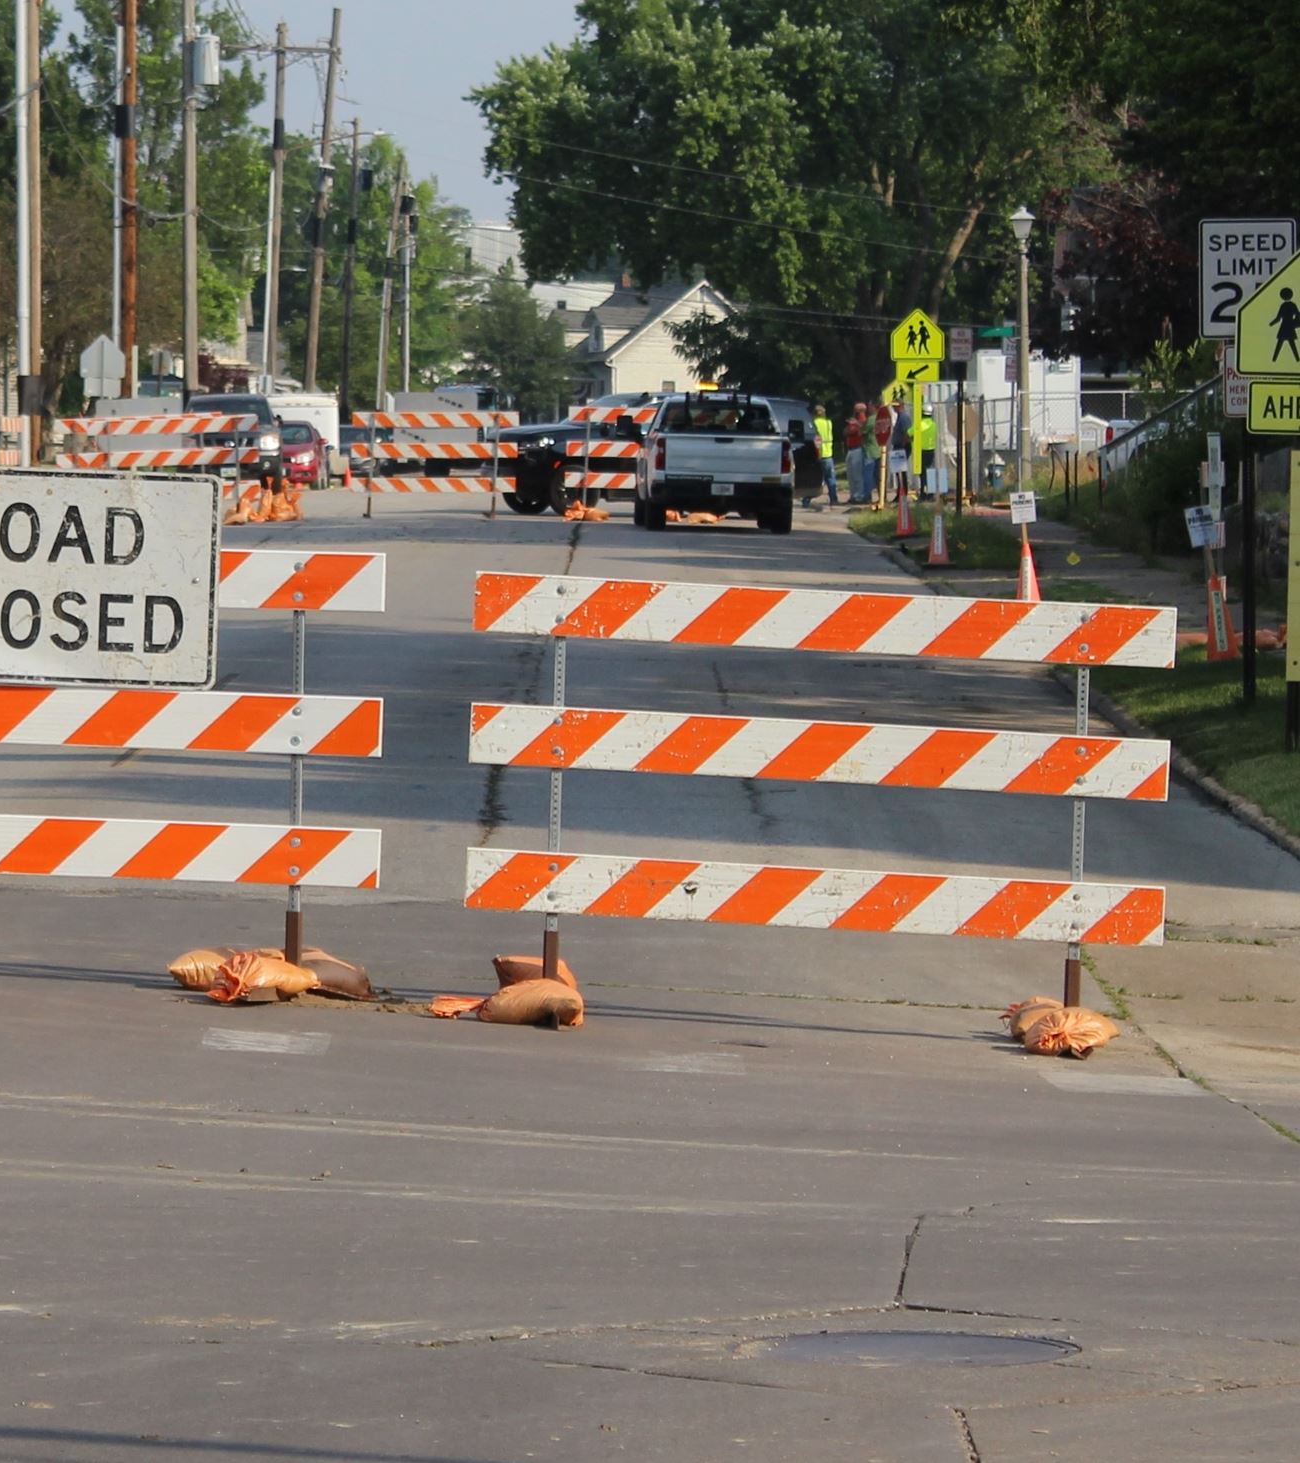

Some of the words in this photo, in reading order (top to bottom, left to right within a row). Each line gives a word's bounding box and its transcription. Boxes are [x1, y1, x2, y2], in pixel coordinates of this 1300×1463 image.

[1209, 234, 1287, 252] SPEED
[1217, 258, 1278, 276] LIMIT
[1210, 281, 1264, 323] 2
